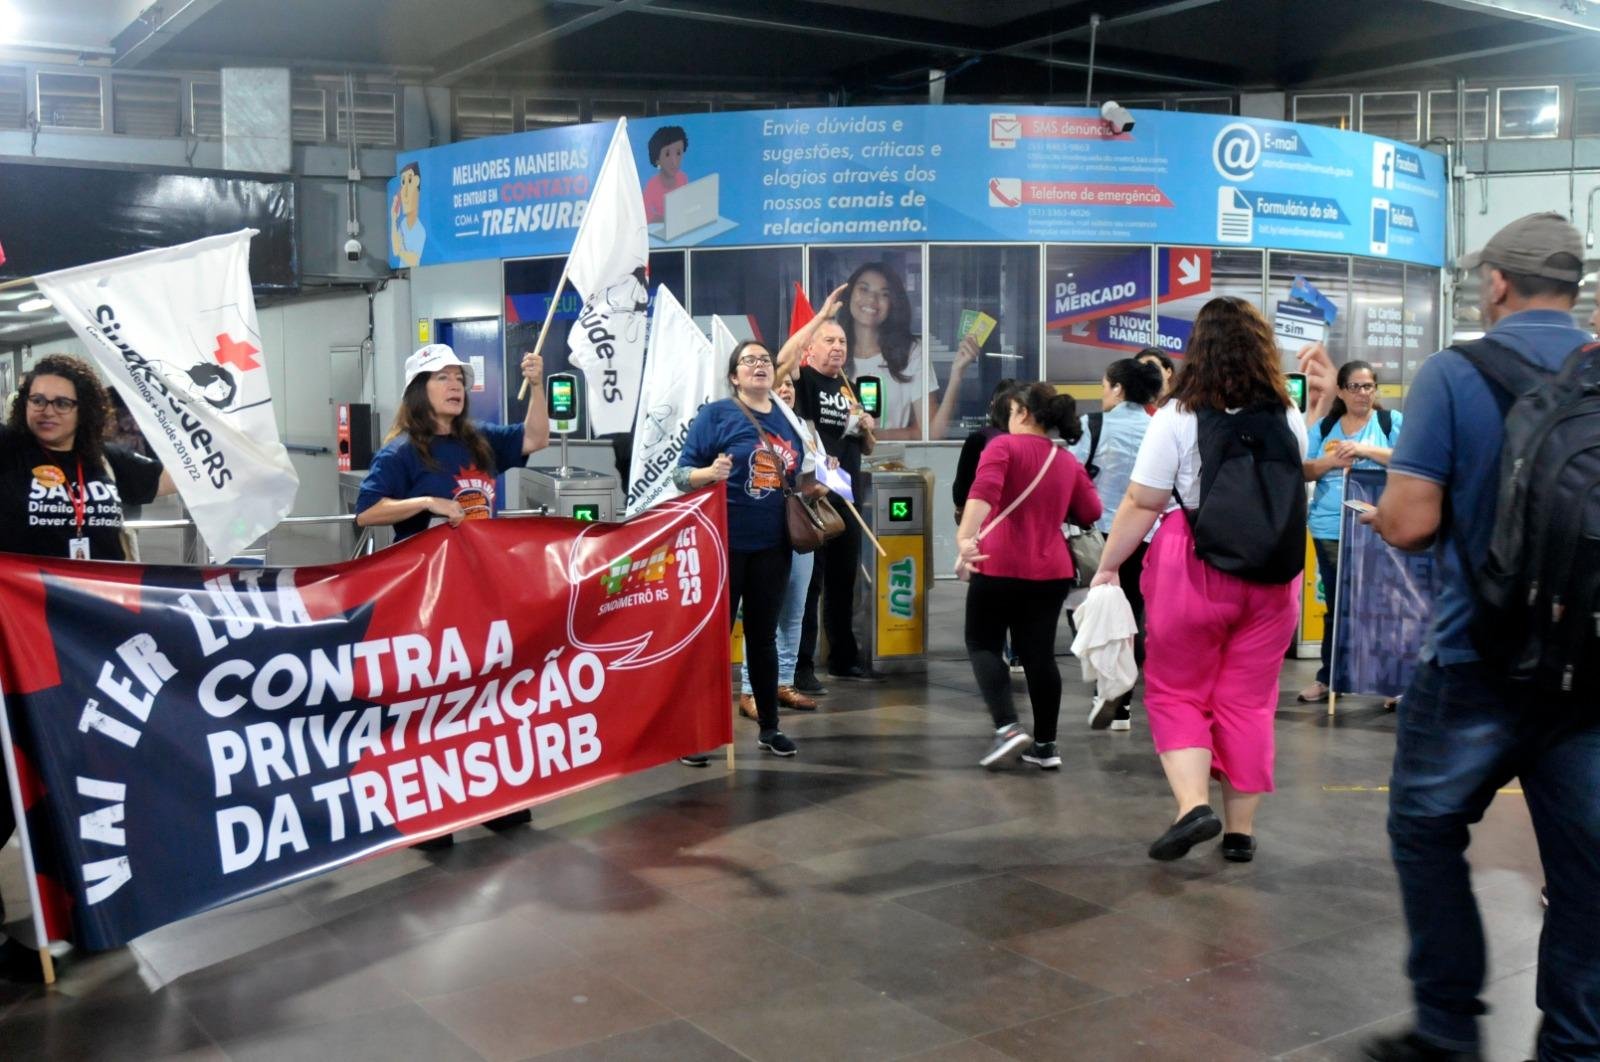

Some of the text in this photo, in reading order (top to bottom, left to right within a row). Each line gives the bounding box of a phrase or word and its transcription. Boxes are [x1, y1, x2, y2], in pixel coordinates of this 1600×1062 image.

[763, 117, 904, 136] Envie dúvidas e
[1032, 121, 1058, 134] SMS
[763, 140, 941, 162] sugestões, críticas e
[1264, 133, 1299, 152] E-mail
[453, 150, 589, 186] MELHORES MANEIRAS
[763, 167, 936, 189] elogios através dos
[453, 174, 590, 208] DE ENTRAR EM CONTATO
[763, 191, 926, 211] nossos canais de
[1031, 186, 1161, 205] Telefone de emergência
[454, 200, 589, 237] COM A TRENSURB
[1257, 198, 1338, 220] Formulário do site
[763, 218, 928, 236] relacionamento.
[1055, 282, 1077, 297] De
[1055, 281, 1136, 315] MERCADO
[1109, 315, 1117, 326] a
[1284, 321, 1305, 336] sim
[819, 391, 852, 410] SAÚ
[154, 409, 176, 442] Saúde
[173, 439, 201, 482] 2019/22
[28, 501, 74, 513] Direito
[83, 503, 95, 513] e
[29, 515, 67, 525] Dever
[69, 516, 86, 526] d
[674, 525, 698, 549] ACT
[676, 547, 700, 578] 20
[679, 576, 702, 607] 23
[891, 557, 913, 617] TEU!
[178, 569, 314, 658] LUTA
[597, 587, 669, 616] SINDIMETRÔ RS
[197, 619, 514, 719] CONTRA A
[78, 632, 179, 749] TER
[207, 645, 606, 798] PRIVATIZAÇÃO
[215, 712, 603, 875] DA TRENSURB
[76, 775, 133, 906] VAI
